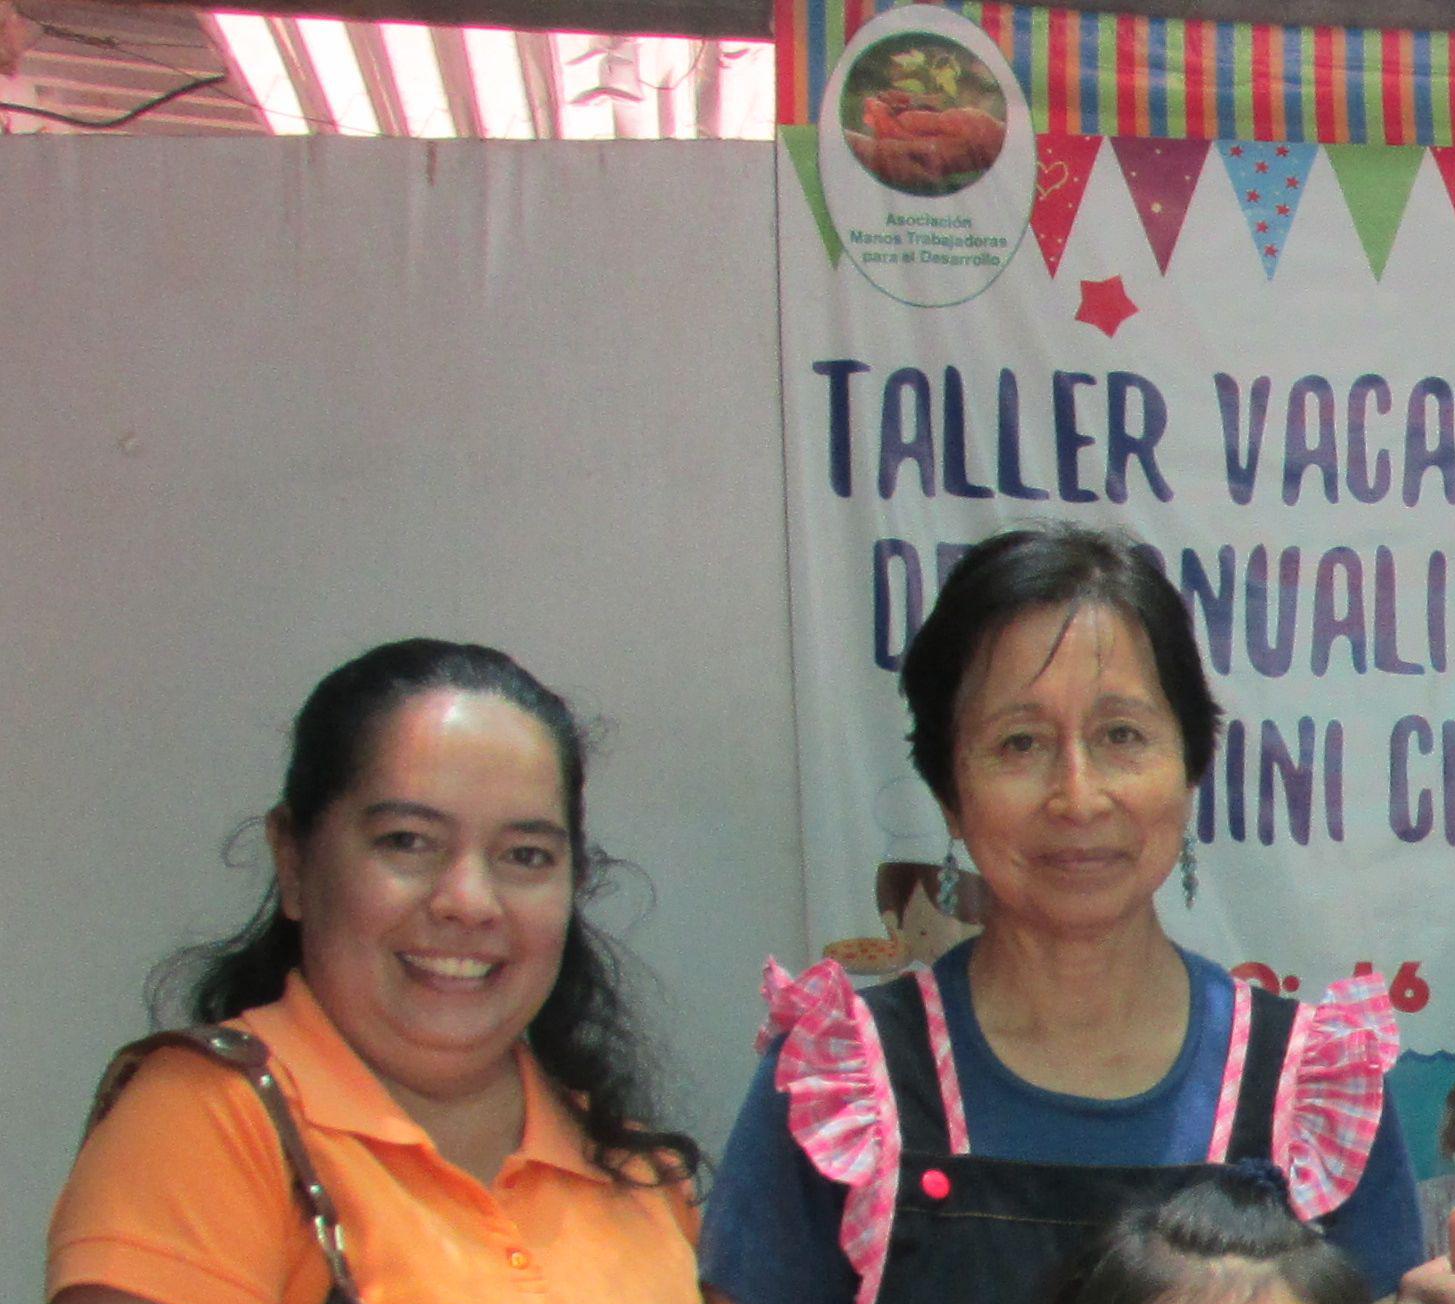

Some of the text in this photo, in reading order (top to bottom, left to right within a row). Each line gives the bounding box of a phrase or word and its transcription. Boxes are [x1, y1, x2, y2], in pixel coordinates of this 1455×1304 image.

[850, 229, 902, 245] Manos
[812, 360, 1173, 504] TALLER
[874, 538, 976, 672] D
[1353, 961, 1430, 1013] 6
